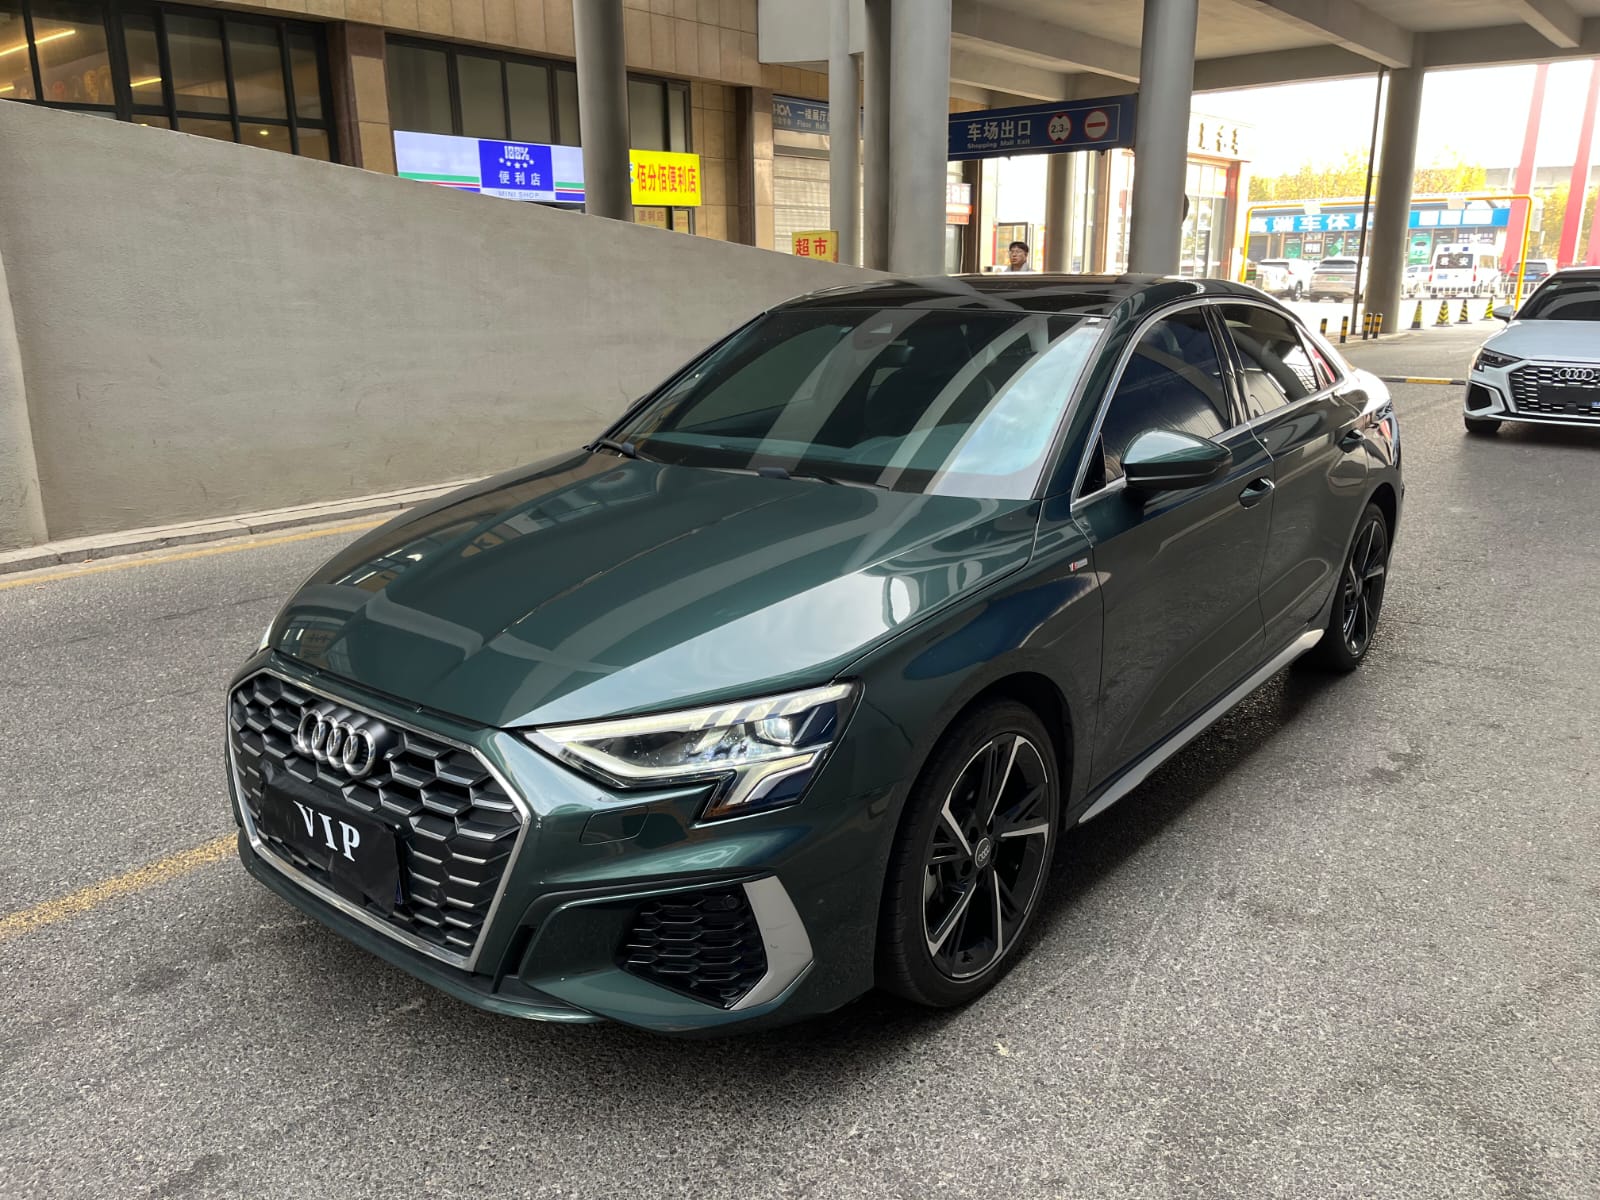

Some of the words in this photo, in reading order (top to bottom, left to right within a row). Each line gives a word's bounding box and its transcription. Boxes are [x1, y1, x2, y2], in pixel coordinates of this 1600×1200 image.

[967, 120, 1031, 141] 车场出口
[499, 170, 541, 187] 便利店
[637, 163, 697, 193] 佰分佰便利店
[795, 236, 828, 257] 超市
[293, 800, 361, 862] VIP
